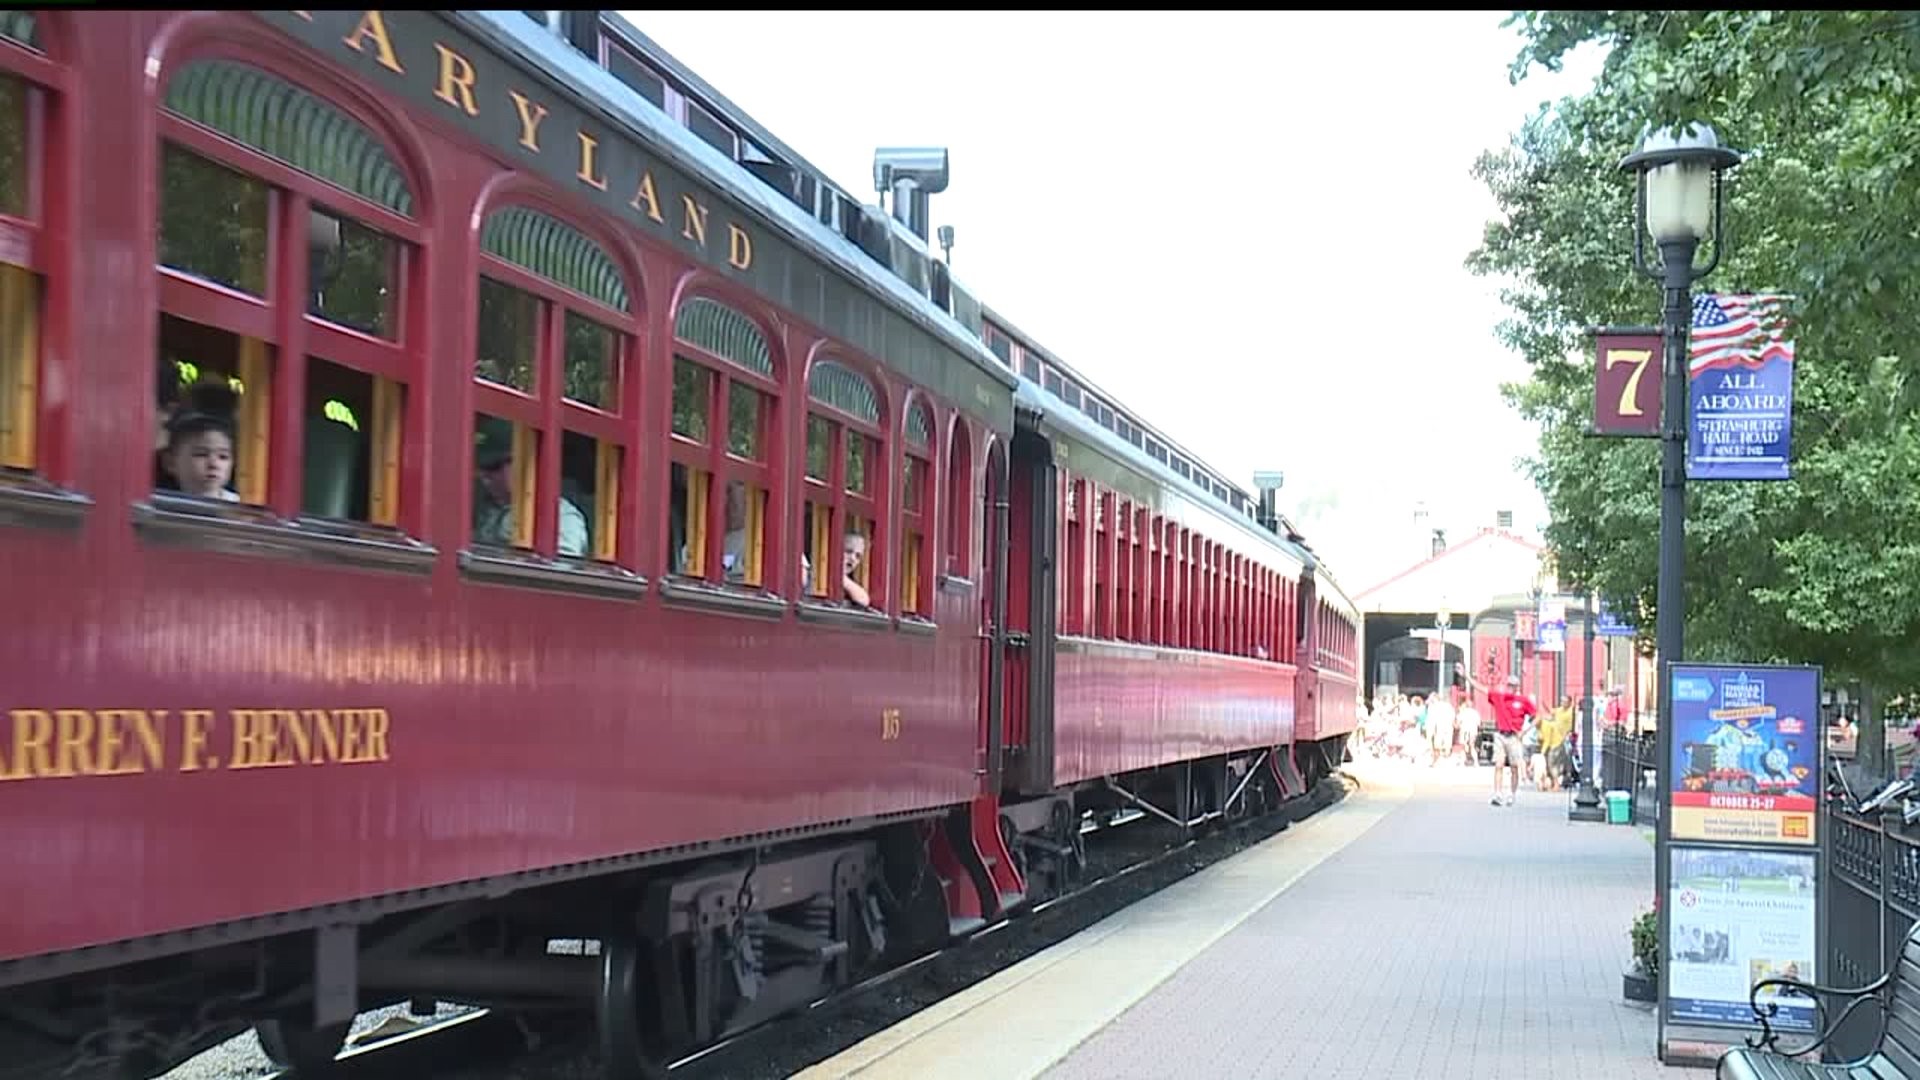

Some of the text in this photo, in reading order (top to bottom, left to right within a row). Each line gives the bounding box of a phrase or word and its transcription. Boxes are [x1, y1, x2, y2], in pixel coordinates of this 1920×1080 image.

[290, 10, 754, 271] ARYLAND
[1606, 350, 1652, 416] 7
[1719, 374, 1764, 389] ALL
[1696, 394, 1786, 410] ABOARD!
[1698, 419, 1783, 432] STRASBURG
[1703, 432, 1778, 444] RAIL ROAD
[882, 707, 901, 741] 105
[180, 709, 218, 772] F.
[228, 708, 390, 770] BENNER
[1710, 796, 1748, 809] OCTOBER
